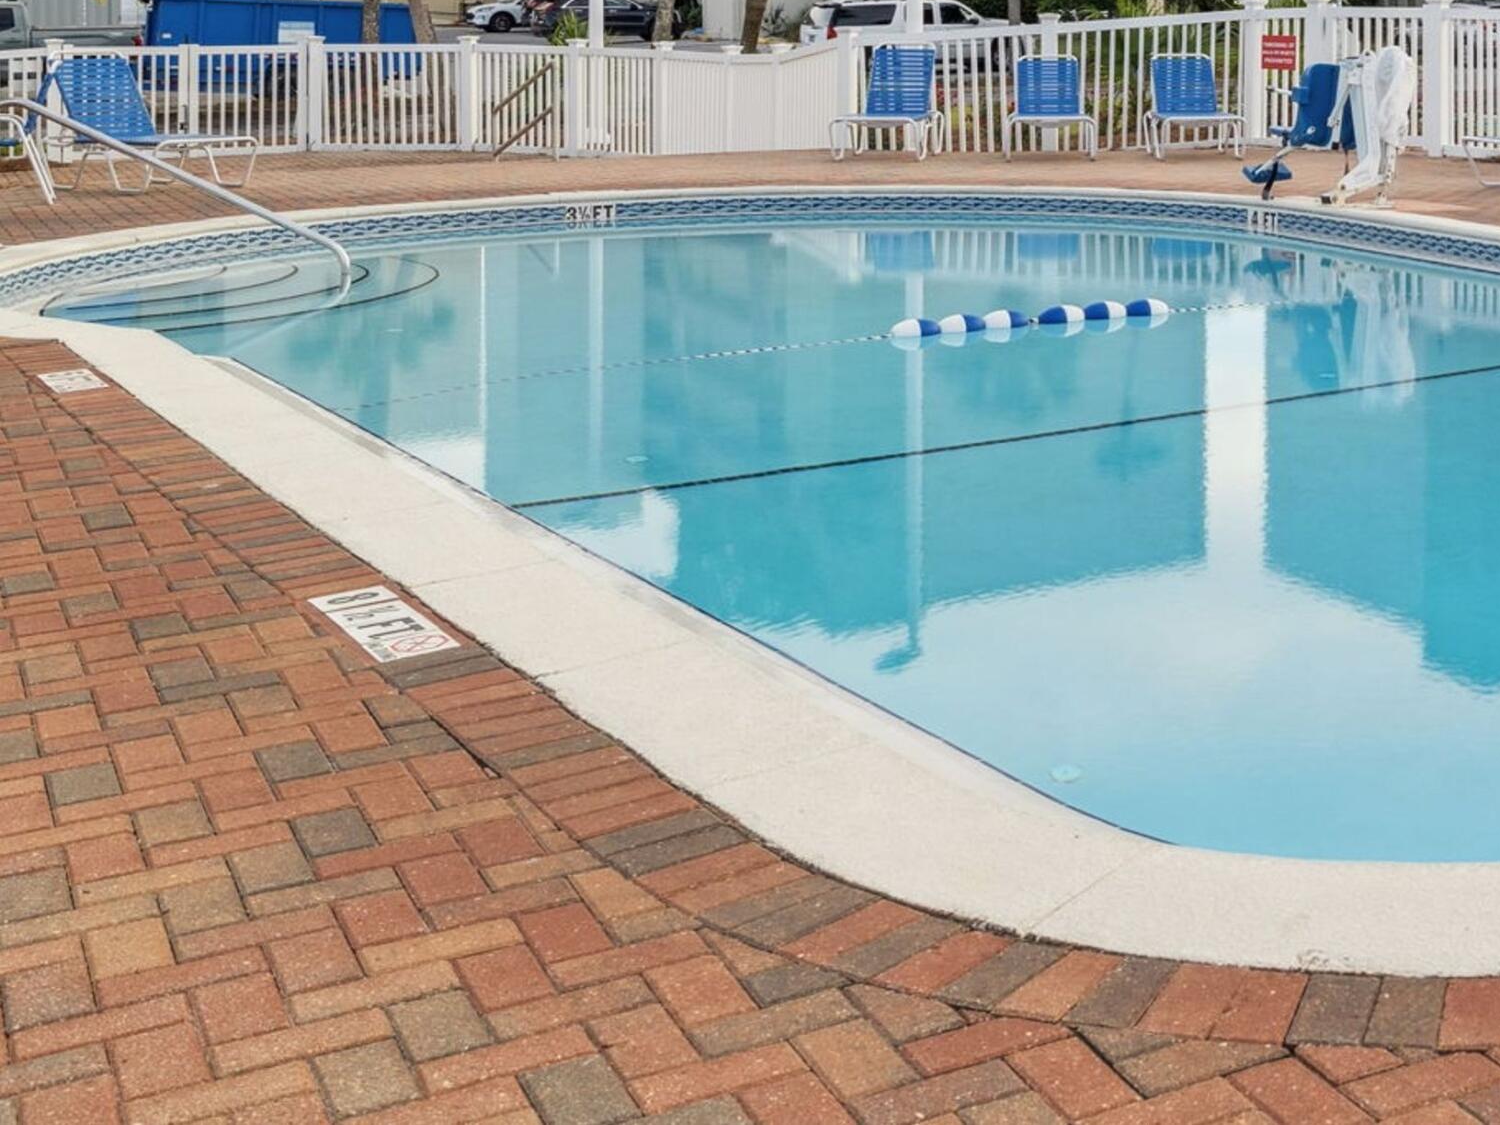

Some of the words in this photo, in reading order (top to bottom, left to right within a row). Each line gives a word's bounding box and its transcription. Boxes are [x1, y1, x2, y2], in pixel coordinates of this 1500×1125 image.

[593, 205, 613, 219] FT
[1251, 211, 1258, 226] 4
[1264, 212, 1276, 230] FT
[357, 617, 425, 640] FT
